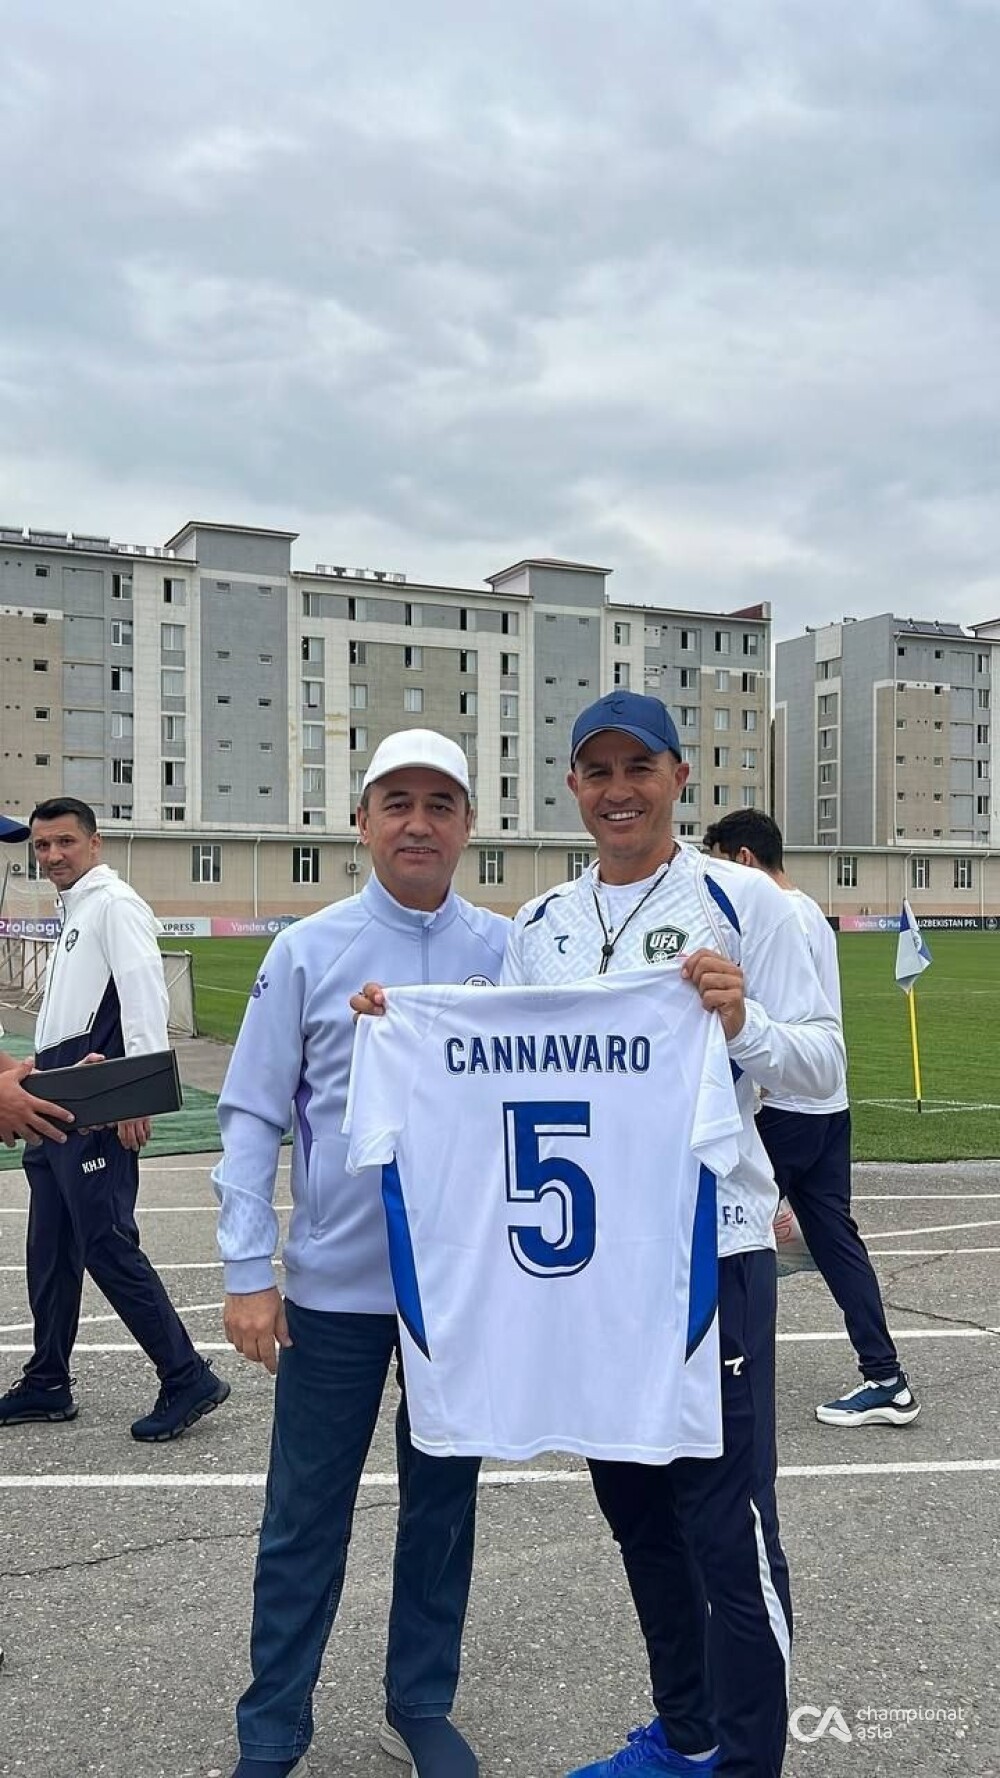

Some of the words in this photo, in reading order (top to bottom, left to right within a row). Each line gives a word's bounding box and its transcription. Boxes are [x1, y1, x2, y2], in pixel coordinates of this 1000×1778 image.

[231, 922, 266, 933] Yandex
[917, 918, 963, 928] UZBEKISTAN
[964, 918, 978, 928] PFL
[650, 932, 680, 950] UFA
[444, 1034, 651, 1075] CANNAVARO
[502, 1101, 597, 1279] 5
[721, 1205, 748, 1226] F.C.
